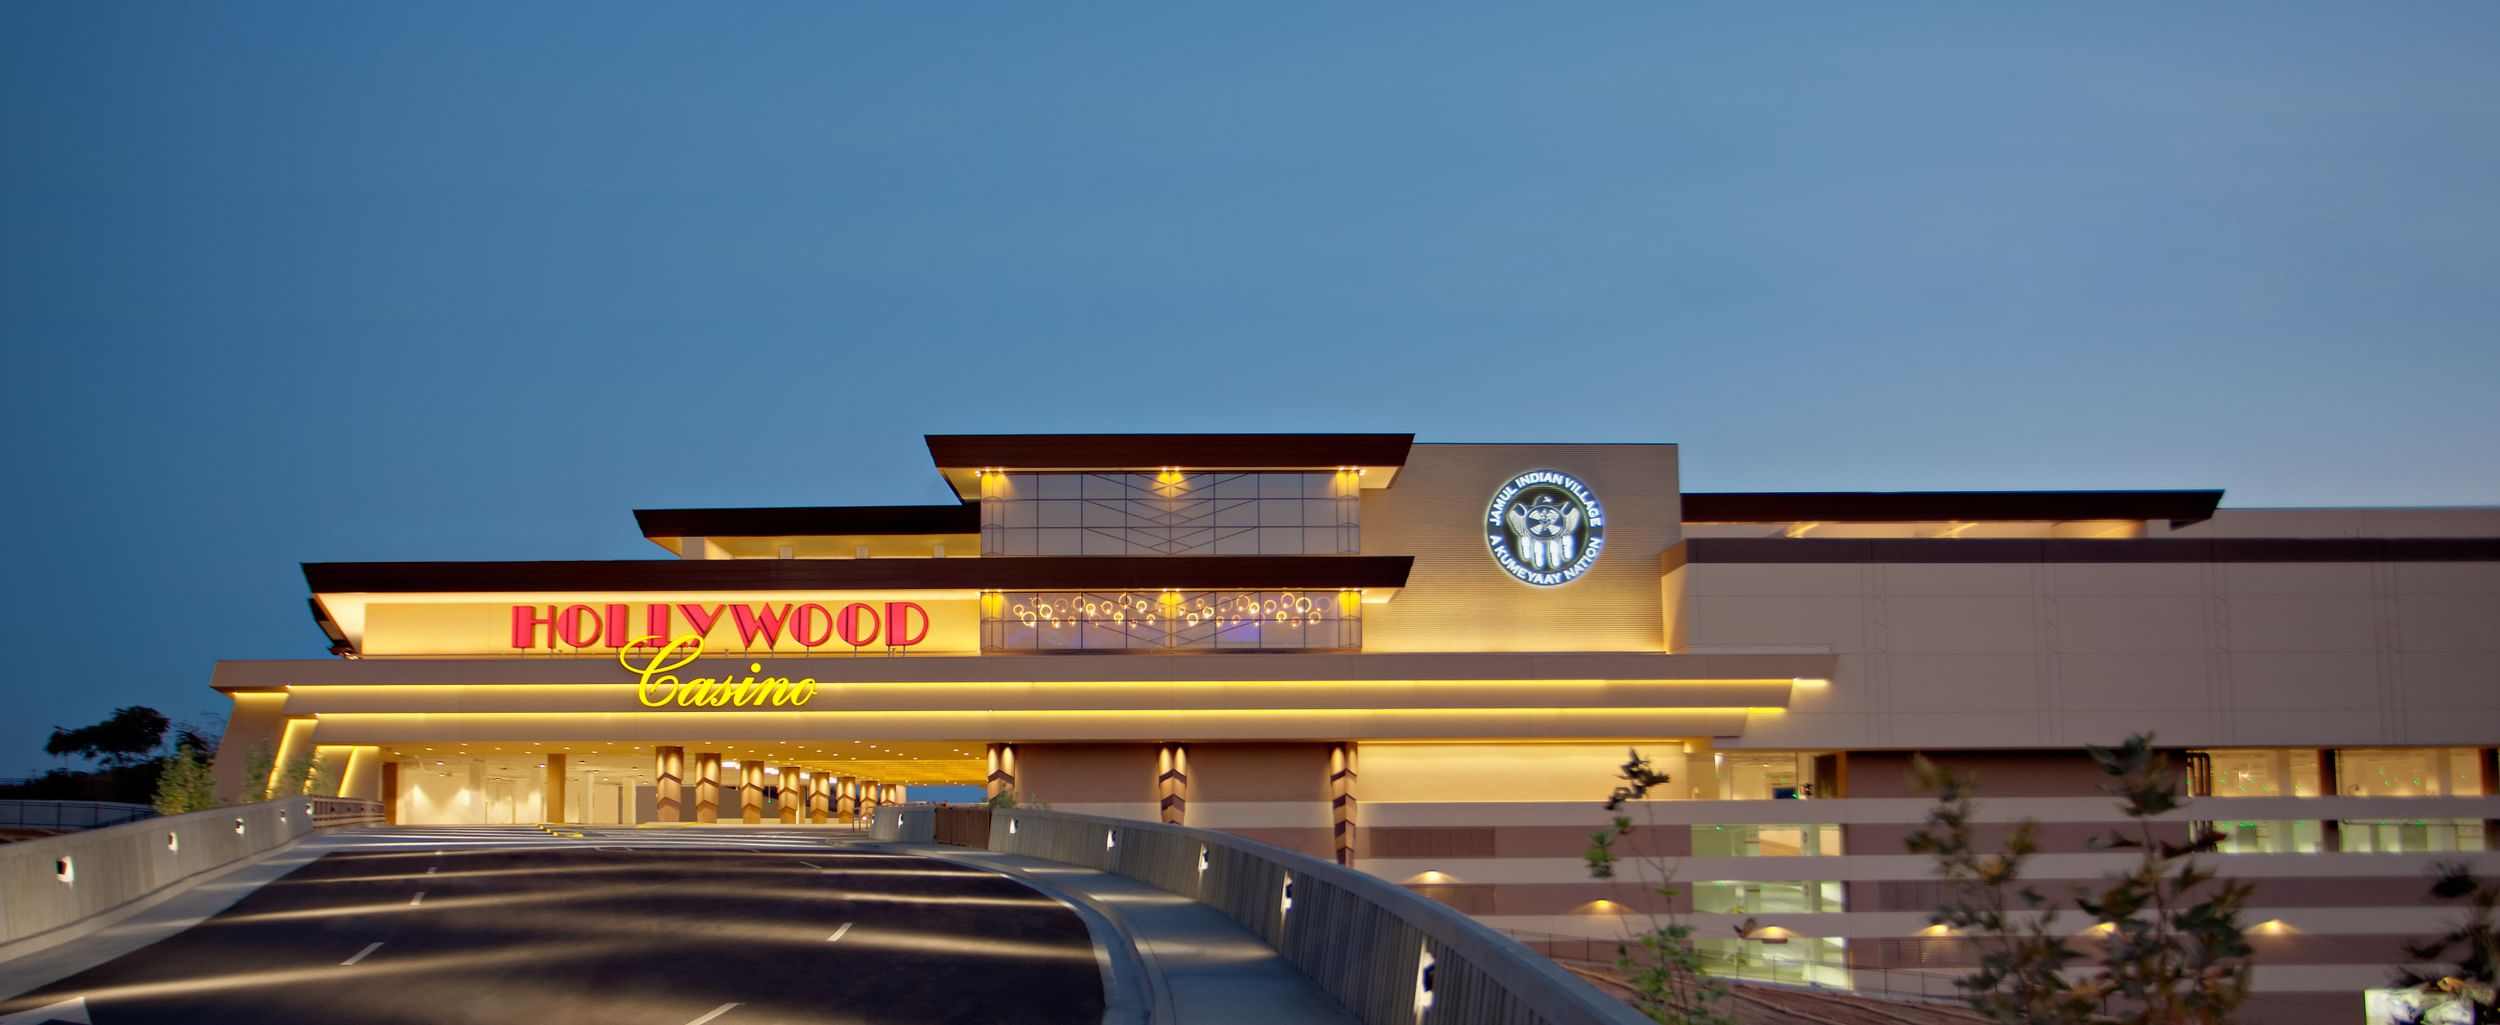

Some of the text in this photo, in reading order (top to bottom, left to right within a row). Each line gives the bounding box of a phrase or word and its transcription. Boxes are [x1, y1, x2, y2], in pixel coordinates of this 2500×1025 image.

[1489, 472, 1601, 527] JAMUL INDIAN VILLAGE
[1489, 535, 1601, 584] A KUMEYAAY NATION
[512, 602, 929, 649] HOLLYWOOD
[620, 633, 818, 707] Casino
